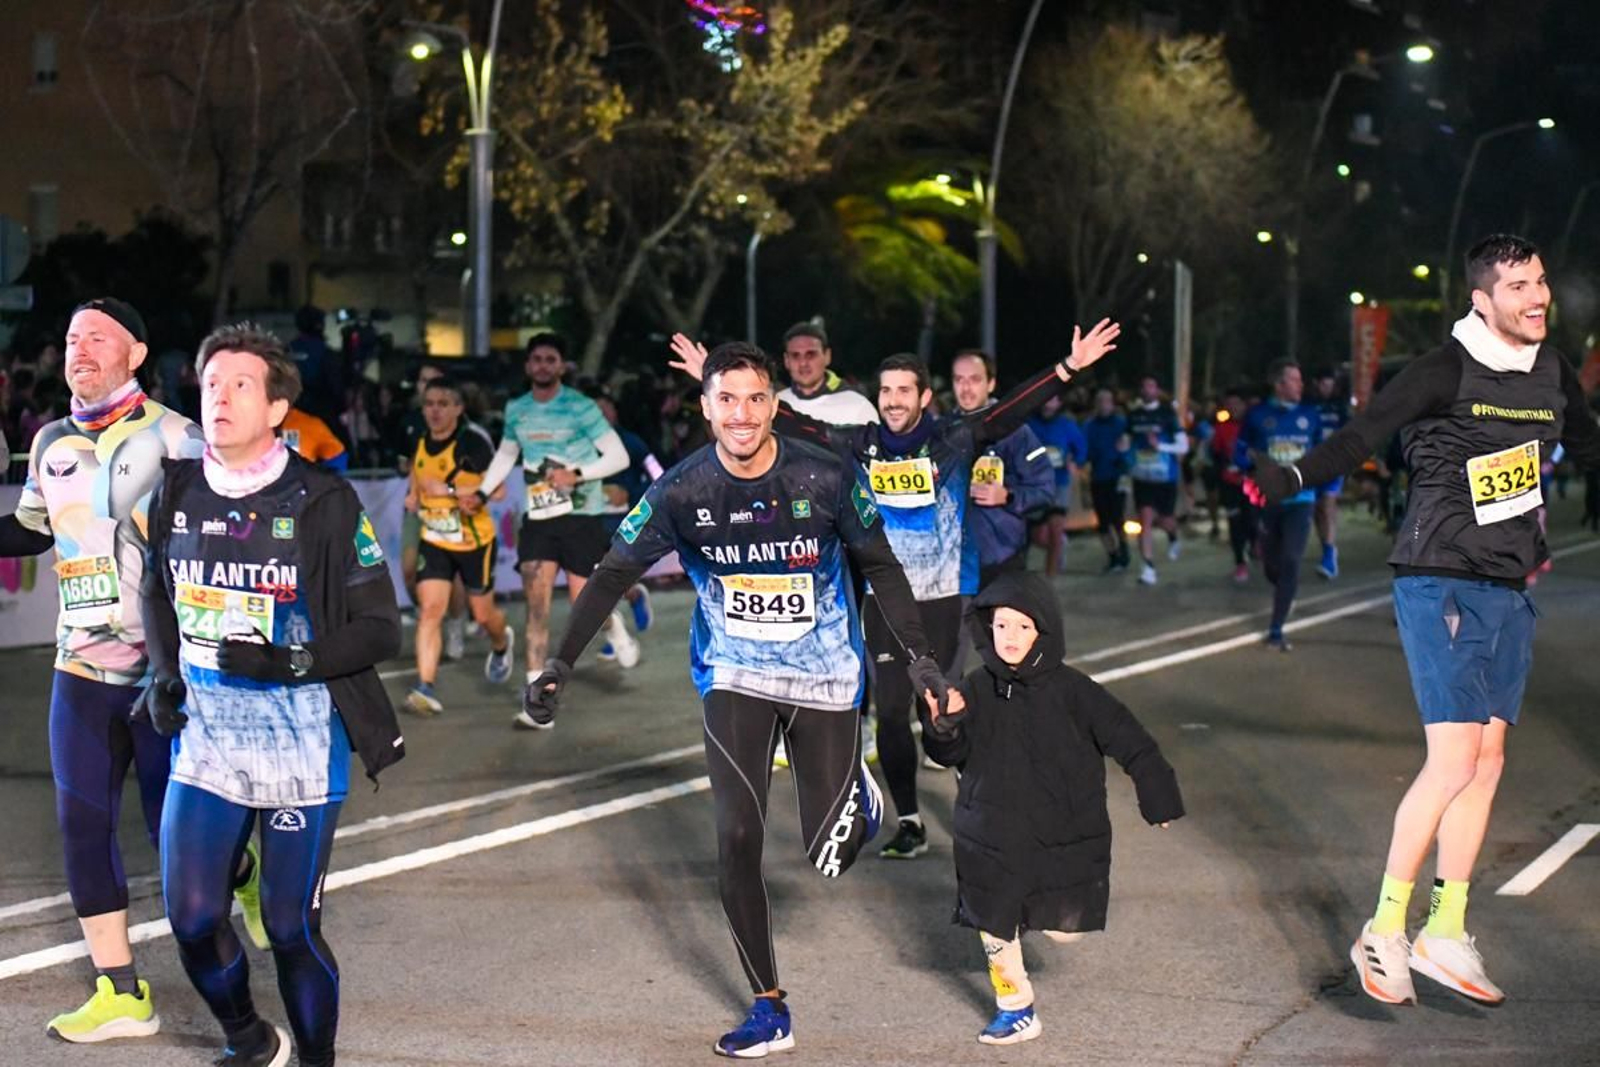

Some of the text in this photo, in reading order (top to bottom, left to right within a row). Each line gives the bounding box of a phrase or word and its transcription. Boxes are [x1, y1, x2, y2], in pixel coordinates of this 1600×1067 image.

[874, 473, 925, 490] 3190
[1478, 460, 1536, 497] 3324
[729, 508, 754, 523] jaén
[700, 534, 820, 565] SAN ANTÓN
[786, 554, 820, 569] 2025
[63, 573, 111, 605] 1680
[168, 557, 298, 590] SAN ANTÓN
[732, 590, 806, 616] 5849
[815, 780, 861, 878] SPORT
